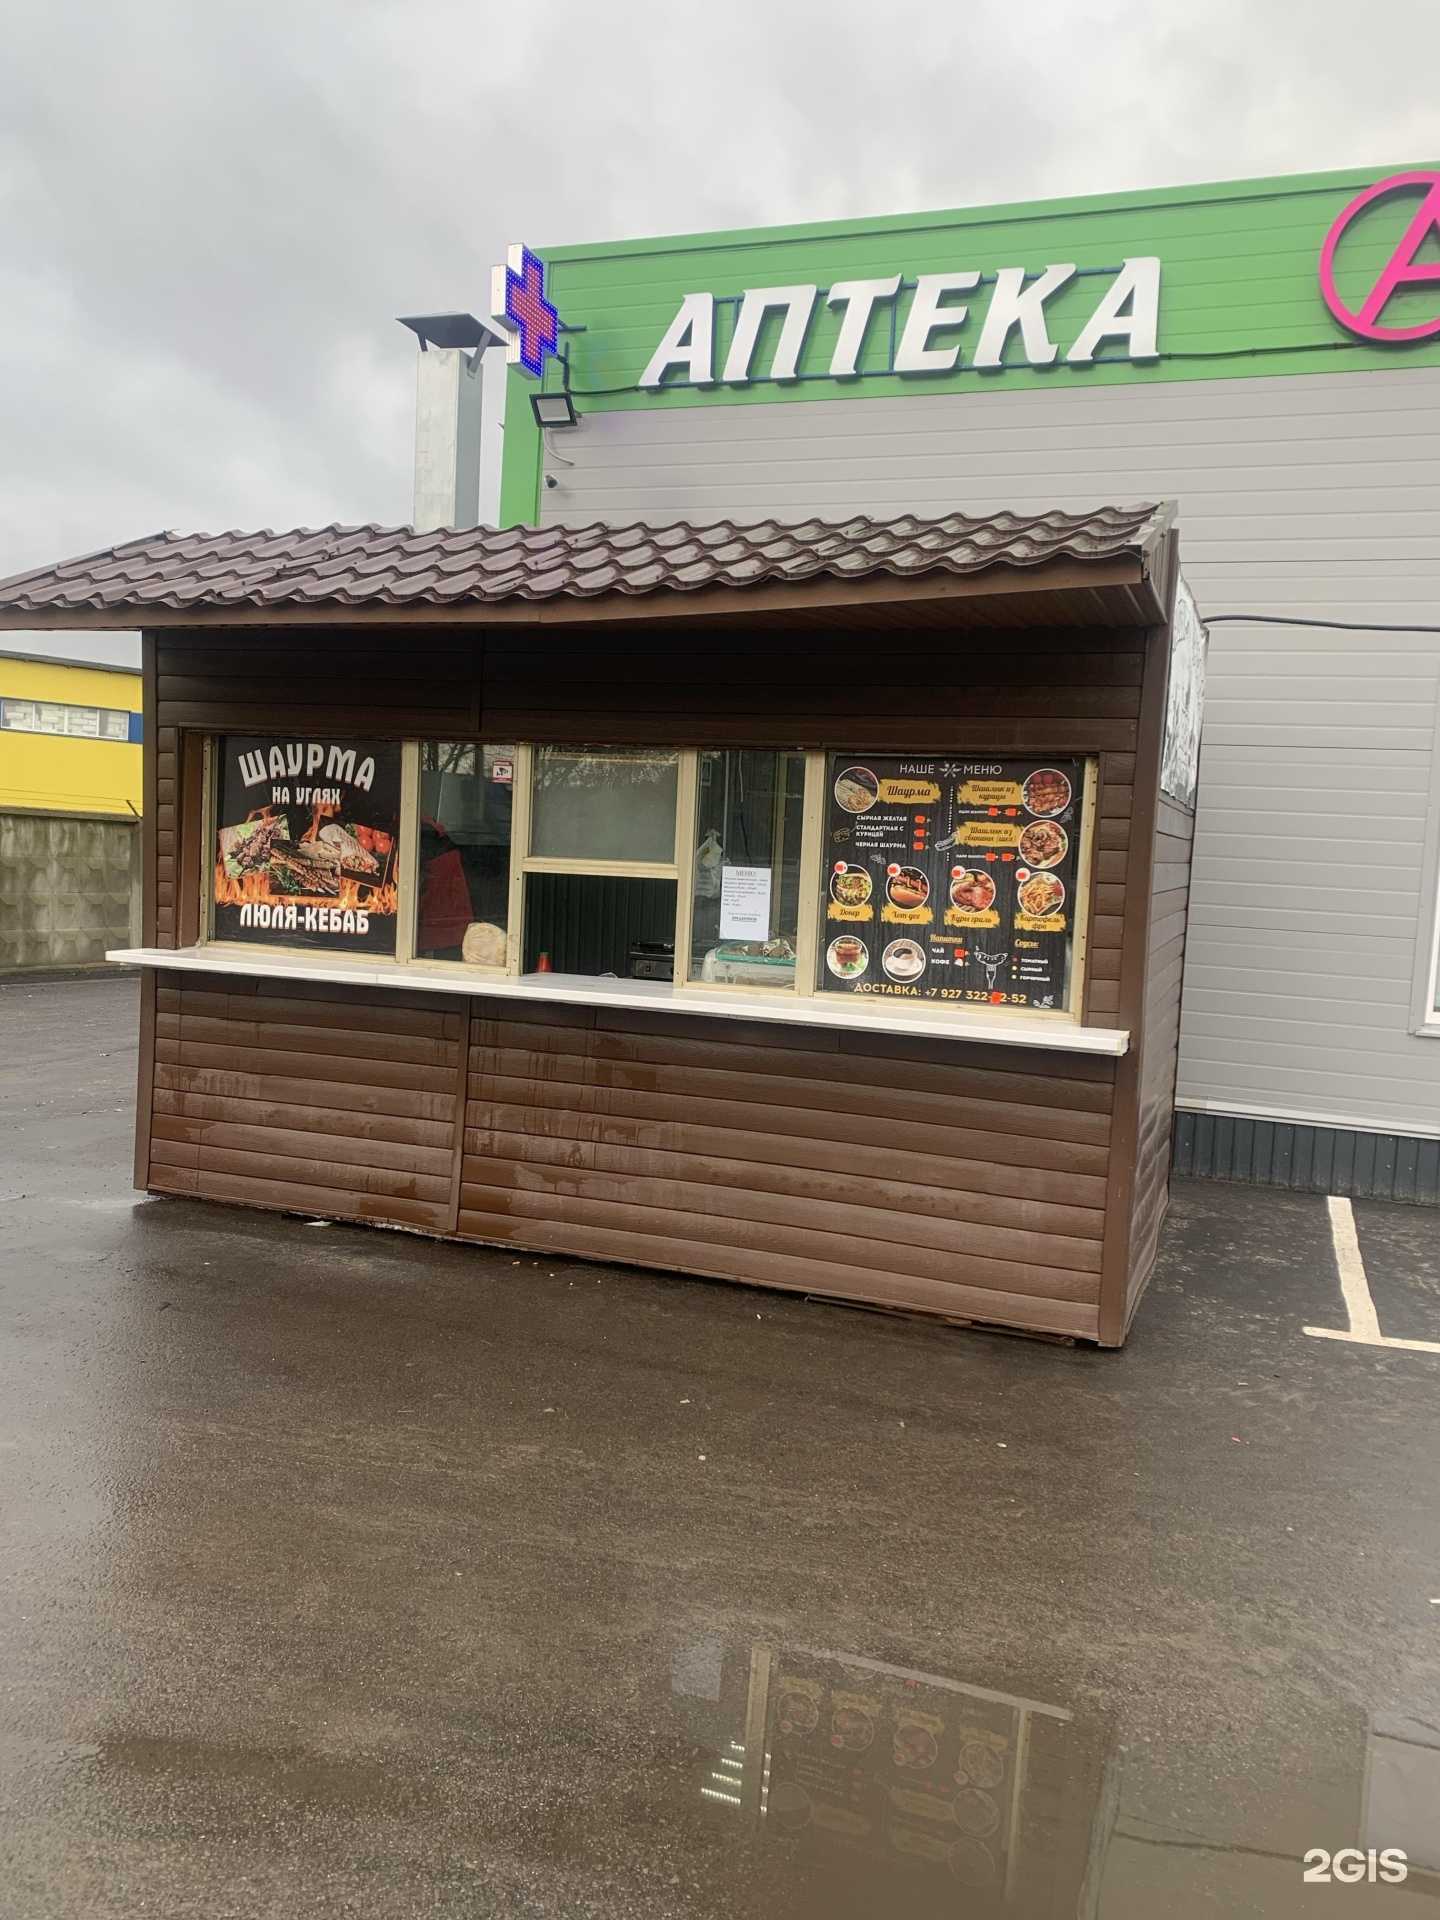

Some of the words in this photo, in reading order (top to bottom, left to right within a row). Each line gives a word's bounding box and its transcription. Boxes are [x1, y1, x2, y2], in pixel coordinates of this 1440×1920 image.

[638, 256, 1161, 390] АПТЕКА
[238, 743, 375, 792] ШАУРМА
[899, 764, 935, 774] НАШЕ
[963, 765, 1002, 775] МЕНЮ
[272, 786, 290, 803] НА
[296, 787, 341, 805] УГЛЯХ
[887, 785, 931, 798] Шаурма
[240, 903, 370, 934] ЛЮЛЯ-КЕБАБ
[853, 983, 922, 996] ДОСТАВКА:
[925, 988, 937, 998] +7
[940, 988, 961, 999] 927
[965, 989, 1027, 1004] 322-2-52
